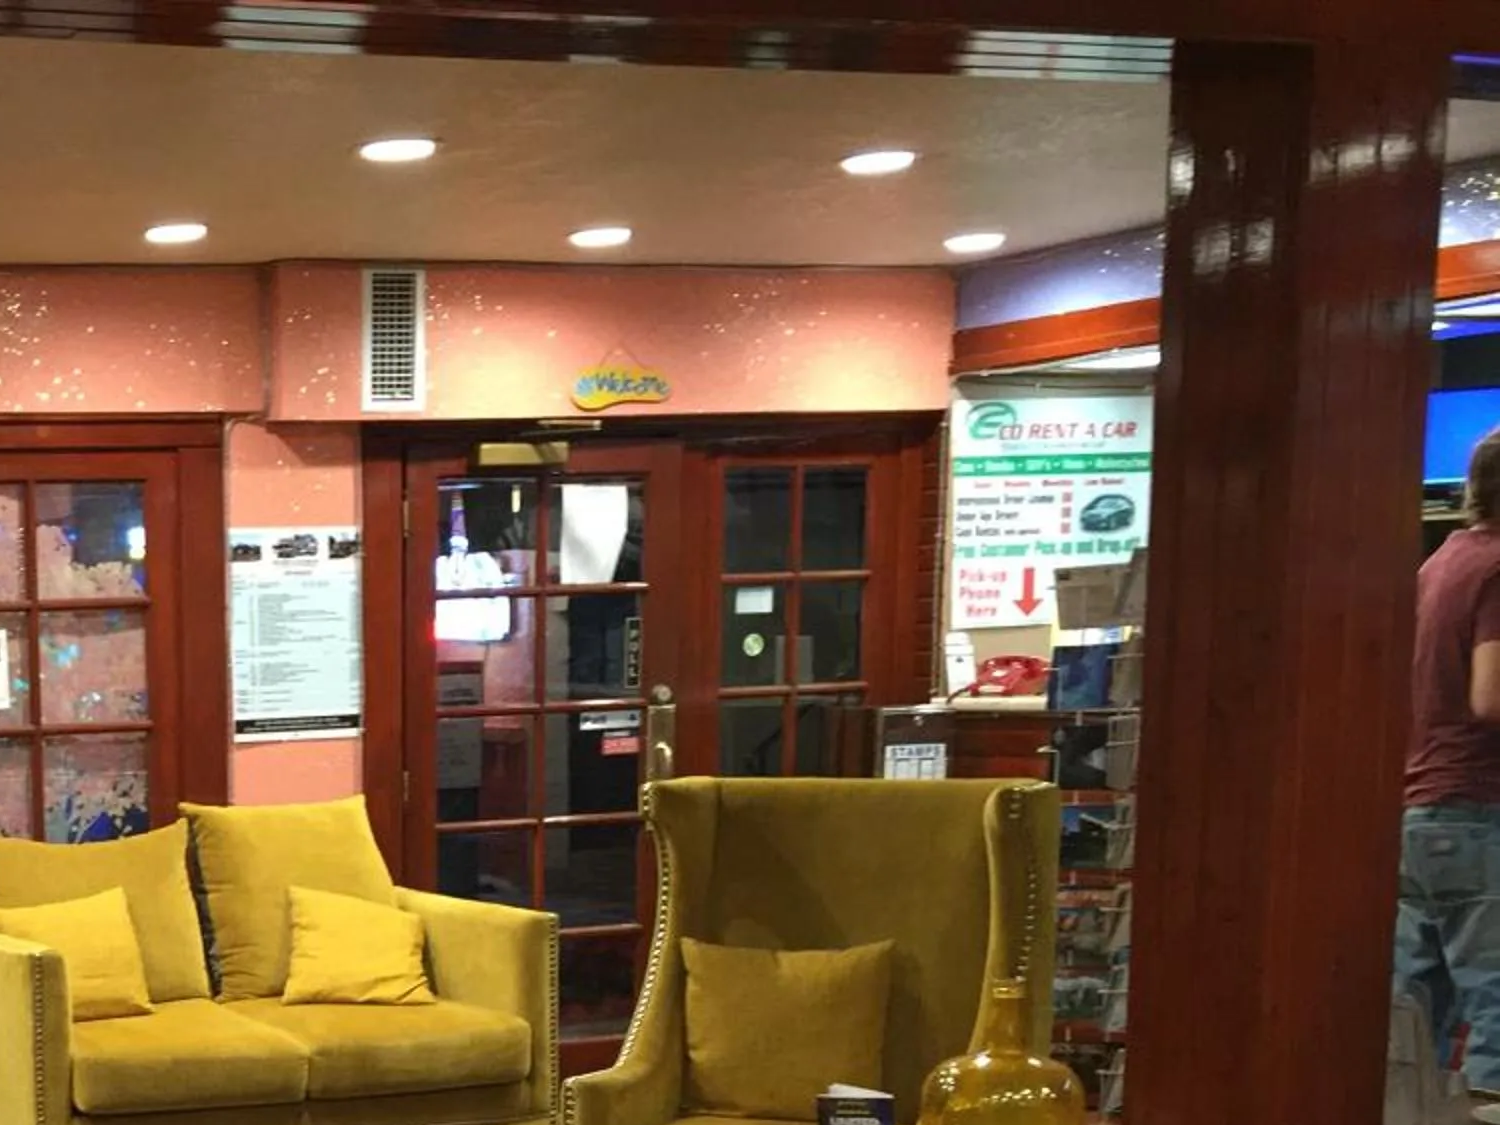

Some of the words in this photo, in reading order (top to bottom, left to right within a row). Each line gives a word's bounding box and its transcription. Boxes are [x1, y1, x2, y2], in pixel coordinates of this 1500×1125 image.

[1028, 422, 1078, 439] RENT
[1084, 422, 1097, 438] A
[1102, 421, 1138, 438] CAR
[891, 745, 940, 758] STAMPS
